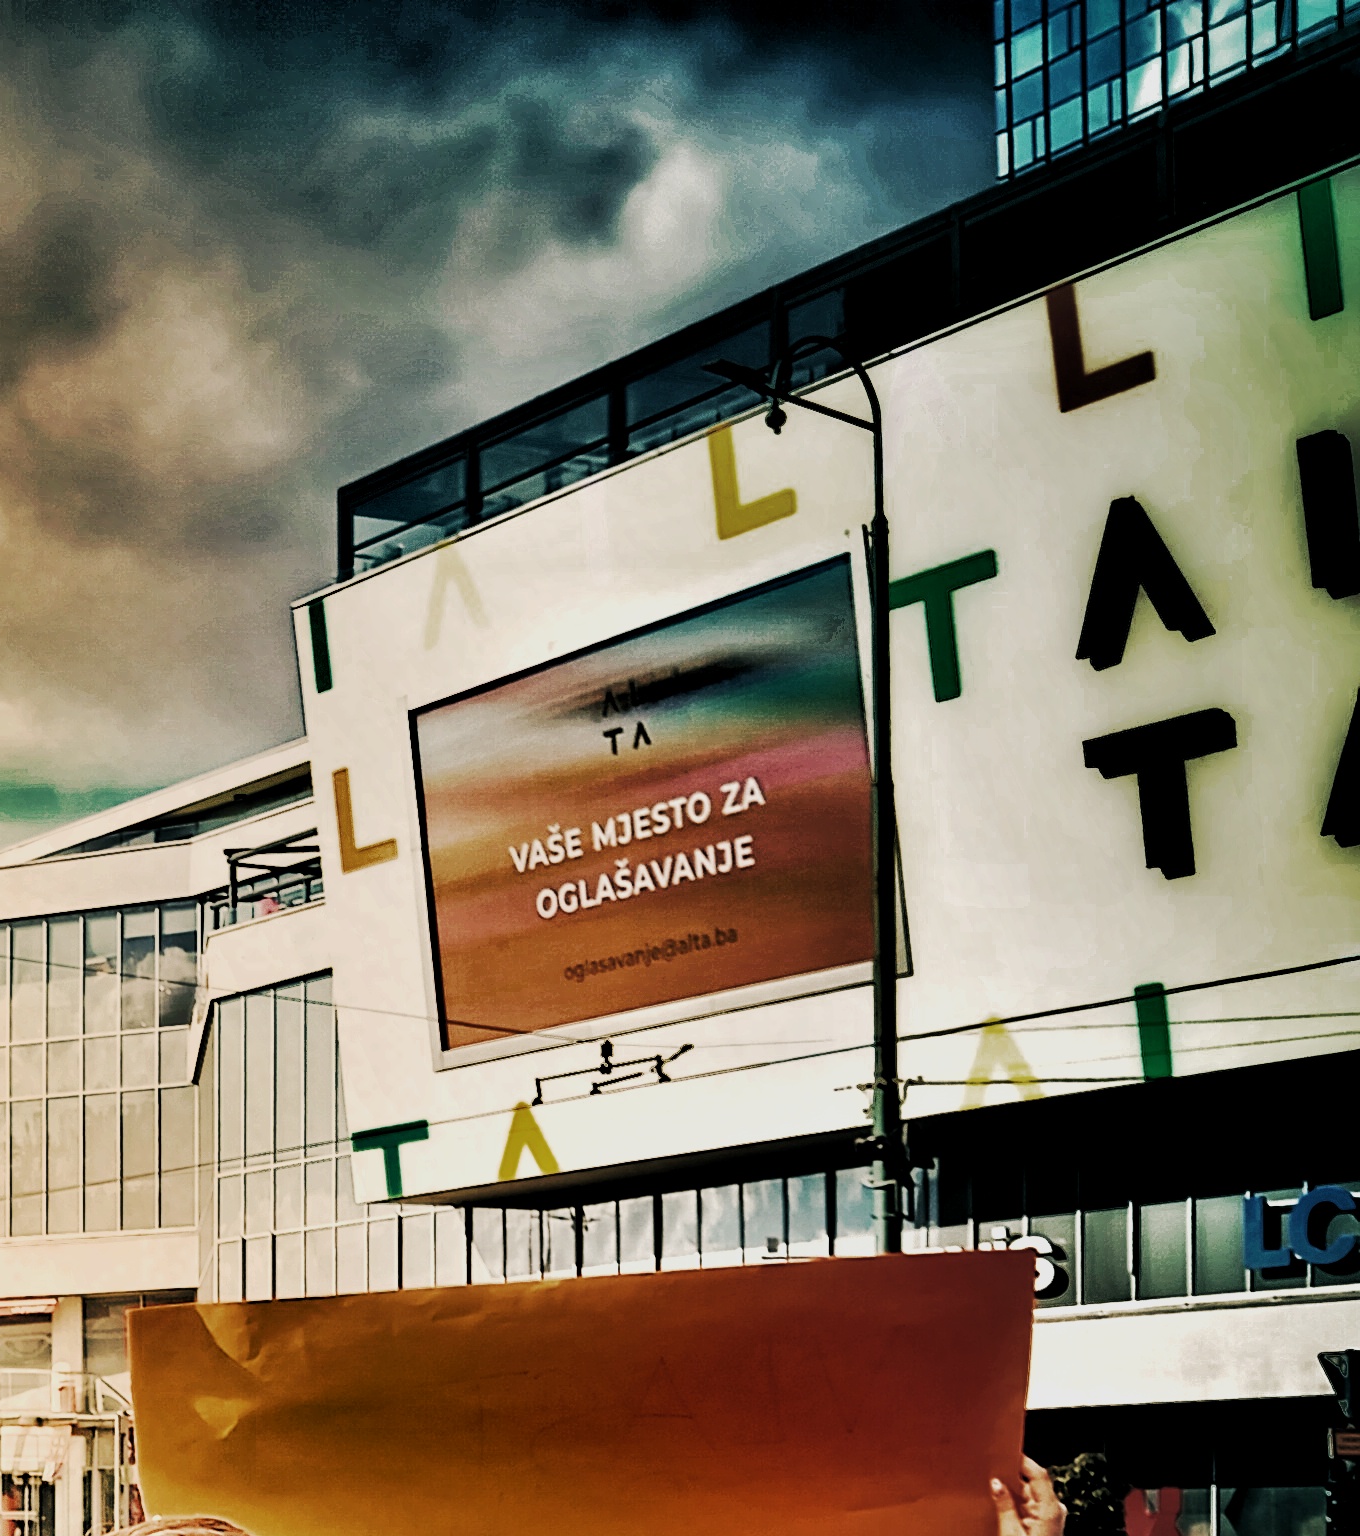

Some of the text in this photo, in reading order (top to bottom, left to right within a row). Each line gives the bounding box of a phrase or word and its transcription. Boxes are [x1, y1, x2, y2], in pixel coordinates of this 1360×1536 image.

[708, 430, 798, 540] L
[508, 776, 767, 874] VAŠE MJESTO ZA
[535, 835, 757, 919] OGLAŠAVANJE
